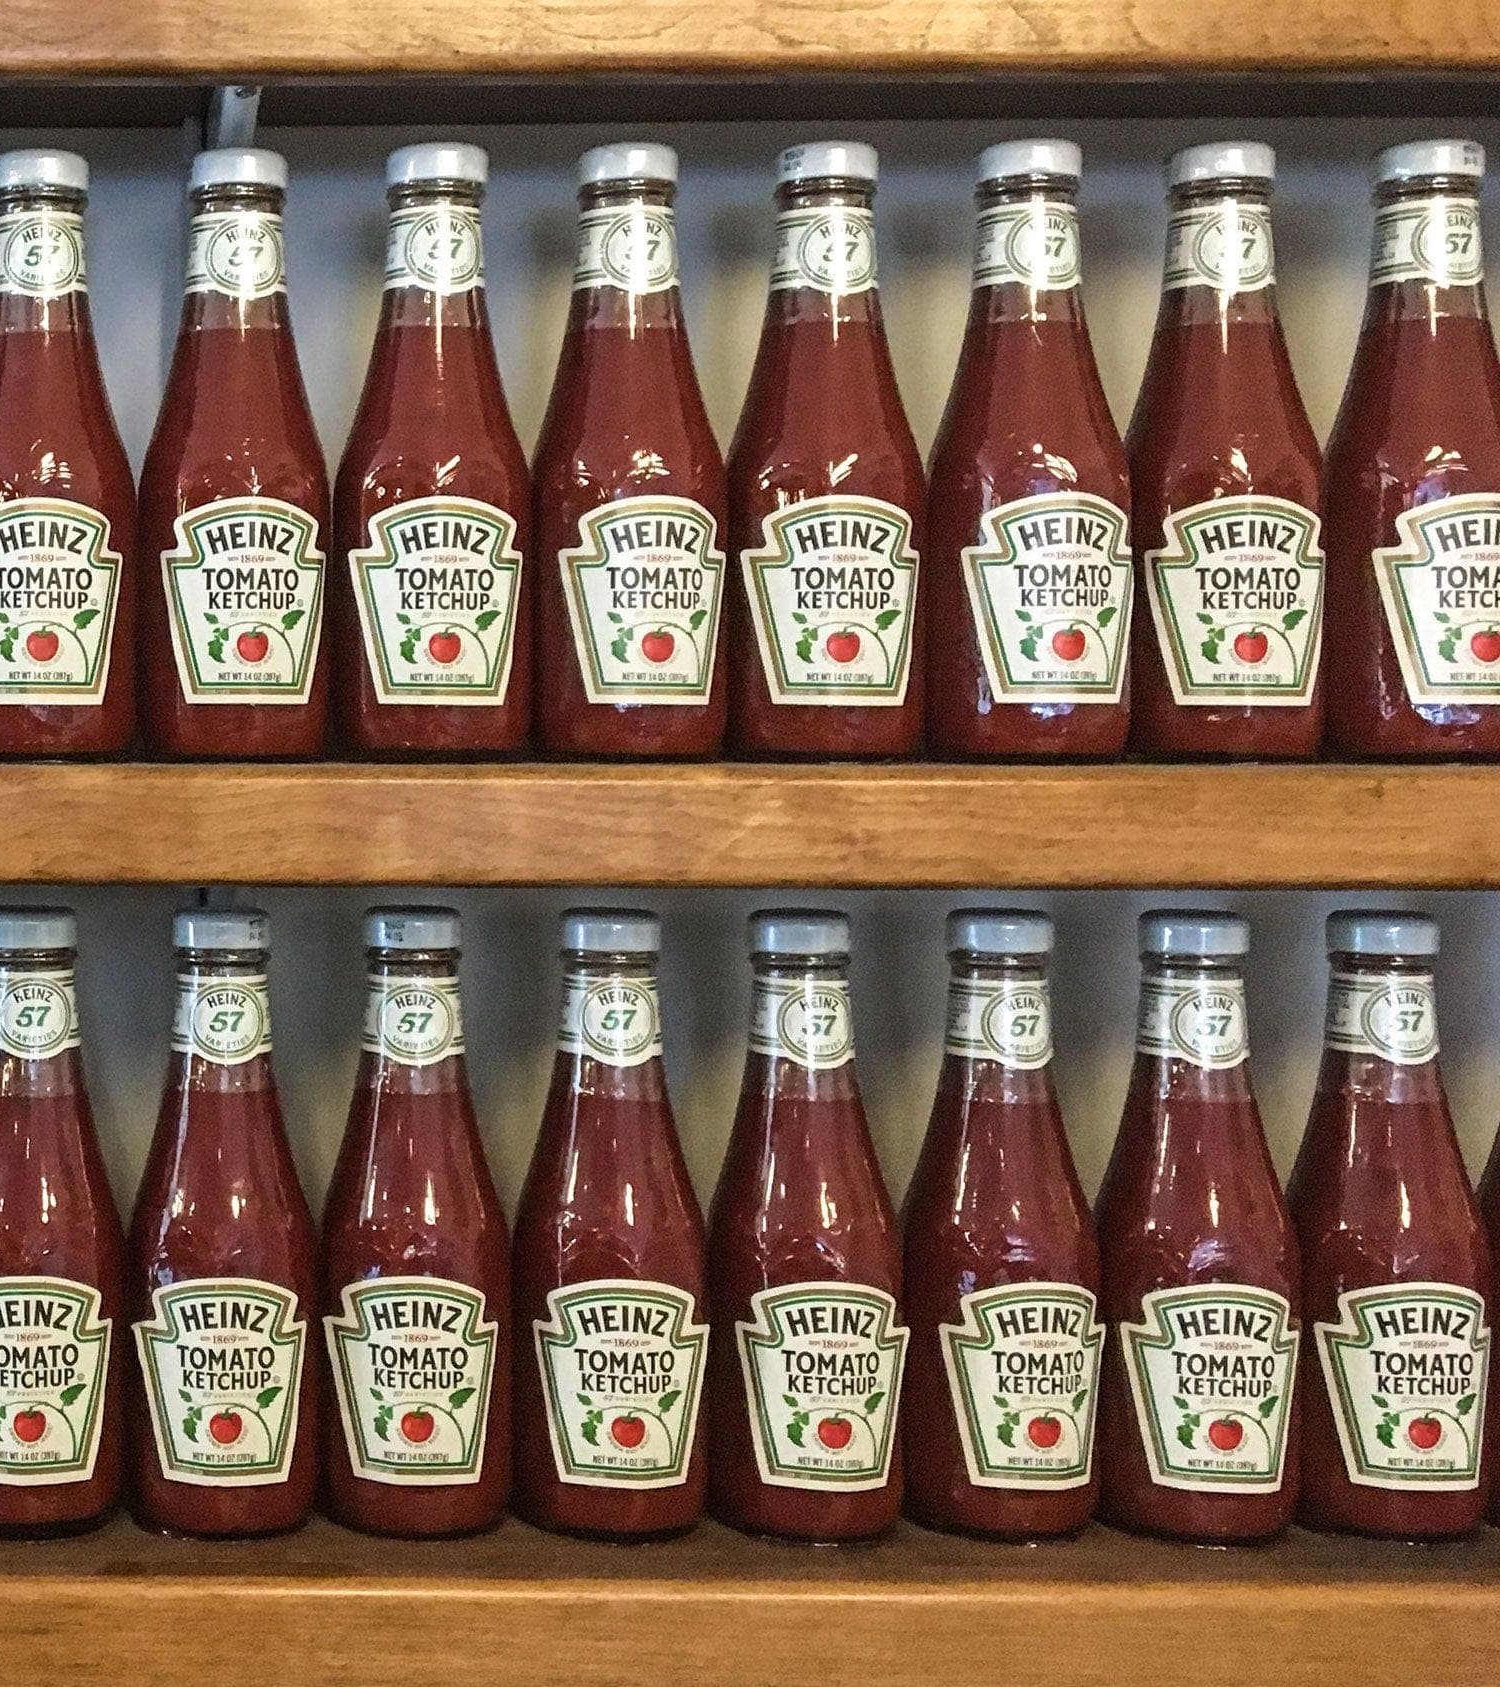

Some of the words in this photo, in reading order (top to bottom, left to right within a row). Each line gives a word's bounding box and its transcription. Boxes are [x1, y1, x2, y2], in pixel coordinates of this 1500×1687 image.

[1446, 234, 1472, 254] 57
[205, 521, 295, 556] HEINZ
[399, 521, 491, 556] HEINZ
[610, 520, 701, 555] HEINZ
[794, 519, 891, 555] HEINZ
[1017, 517, 1109, 552] HEINZ
[1199, 519, 1296, 554] HEINZ
[31, 554, 54, 562] 1869
[241, 555, 264, 563] 1869
[201, 567, 299, 592] TOMATO
[394, 567, 495, 592] TOMATO
[605, 566, 703, 591] TOMATO
[790, 566, 895, 591] TOMATO
[1013, 564, 1112, 588] TOMATO
[1194, 567, 1301, 591] TOMATO
[0, 590, 89, 610] KETCHUP
[208, 591, 296, 610] KETCHUP
[401, 591, 491, 611] KETCHUP
[612, 590, 701, 610] KETCHUP
[797, 590, 891, 610] KETCHUP
[1021, 588, 1109, 608] KETCHUP
[1202, 591, 1297, 610] KETCHUP
[207, 994, 247, 1008] HEINZ
[395, 995, 436, 1009] HEINZ
[599, 993, 638, 1006] HEINZ
[1193, 998, 1232, 1011] HEINZ
[16, 1006, 51, 1027] 57
[209, 1011, 244, 1032] 57
[397, 1013, 433, 1033] 57
[601, 1010, 637, 1031] 57
[802, 1015, 837, 1036] 57
[1011, 1015, 1041, 1036] 57
[11, 1029, 57, 1044] VARIETIES
[178, 1300, 270, 1334] HEINZ
[370, 1300, 463, 1335] HEINZ
[576, 1304, 670, 1338] HEINZ
[784, 1306, 876, 1340] HEINZ
[994, 1306, 1082, 1339] HEINZ
[1175, 1307, 1273, 1344] HEINZ
[1373, 1306, 1471, 1341] HEINZ
[404, 1334, 428, 1342] 1869
[614, 1339, 639, 1347] 1869
[176, 1343, 276, 1372] TOMATO
[367, 1342, 469, 1371] TOMATO
[573, 1348, 675, 1376] TOMATO
[780, 1349, 880, 1377] TOMATO
[991, 1349, 1085, 1377] TOMATO
[1171, 1350, 1276, 1379] TOMATO
[1369, 1349, 1474, 1377] TOMATO
[182, 1368, 272, 1391] KETCHUP
[374, 1367, 465, 1390] KETCHUP
[581, 1372, 672, 1395] KETCHUP
[787, 1373, 877, 1397] KETCHUP
[998, 1373, 1082, 1396] KETCHUP
[1178, 1375, 1273, 1398] KETCHUP
[1377, 1374, 1471, 1396] KETCHUP
